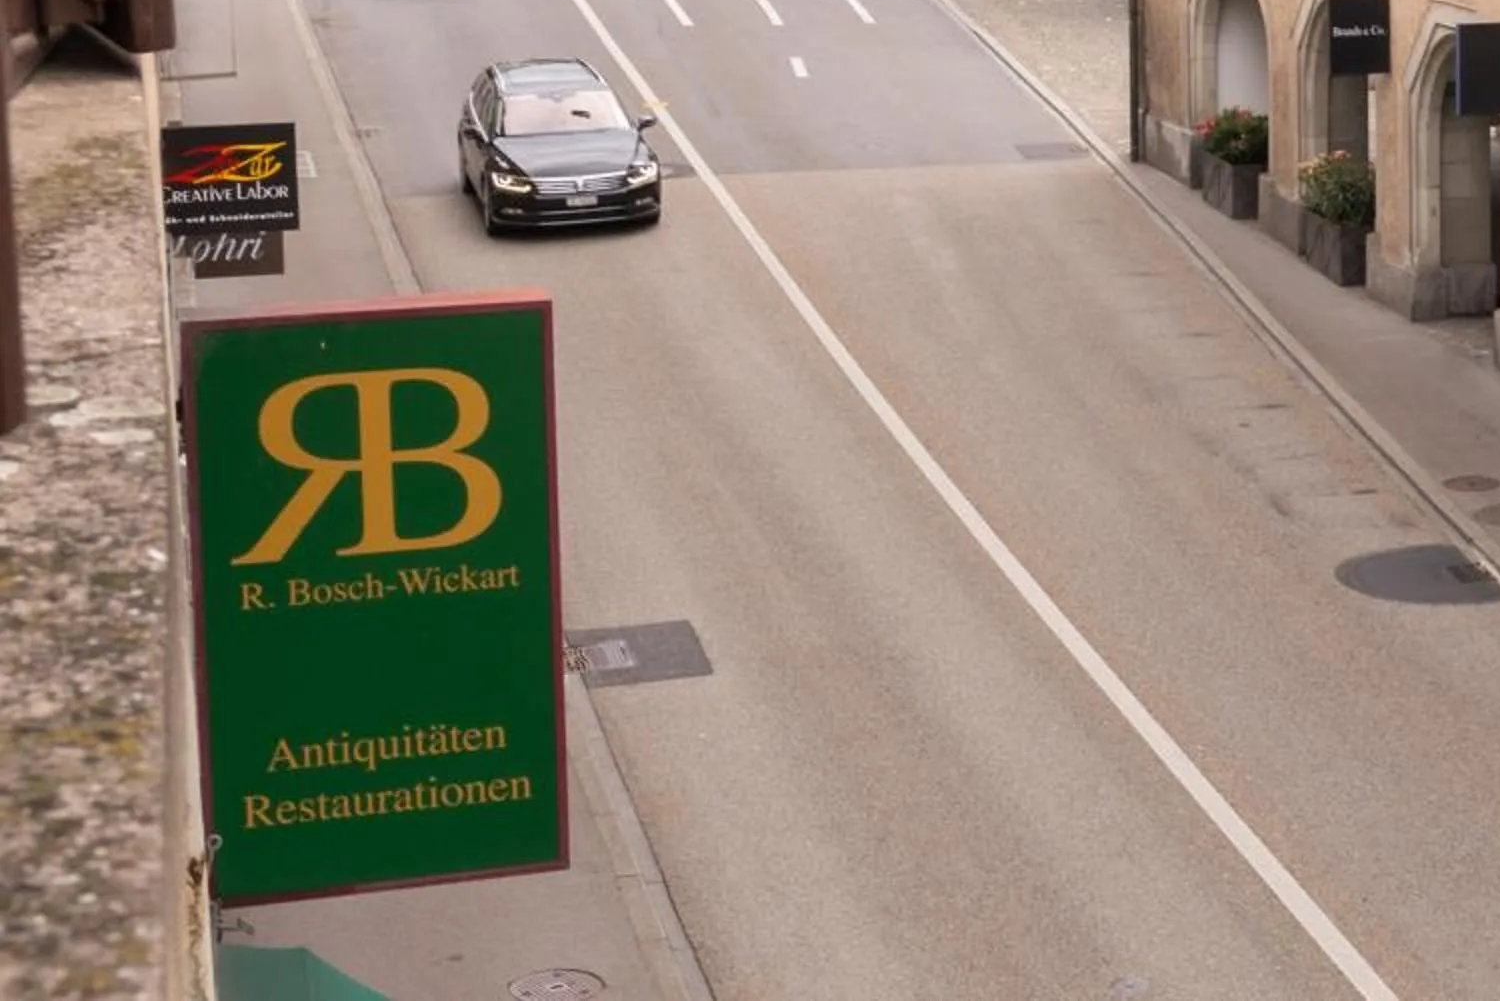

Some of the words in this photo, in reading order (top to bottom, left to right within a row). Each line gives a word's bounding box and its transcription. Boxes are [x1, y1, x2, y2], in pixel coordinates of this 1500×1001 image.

[185, 213, 206, 224] und
[240, 582, 276, 611] R.
[287, 563, 520, 607] Bosch-Wickart
[266, 723, 507, 773] Antiquitäten
[243, 775, 533, 829] Restaurationen
